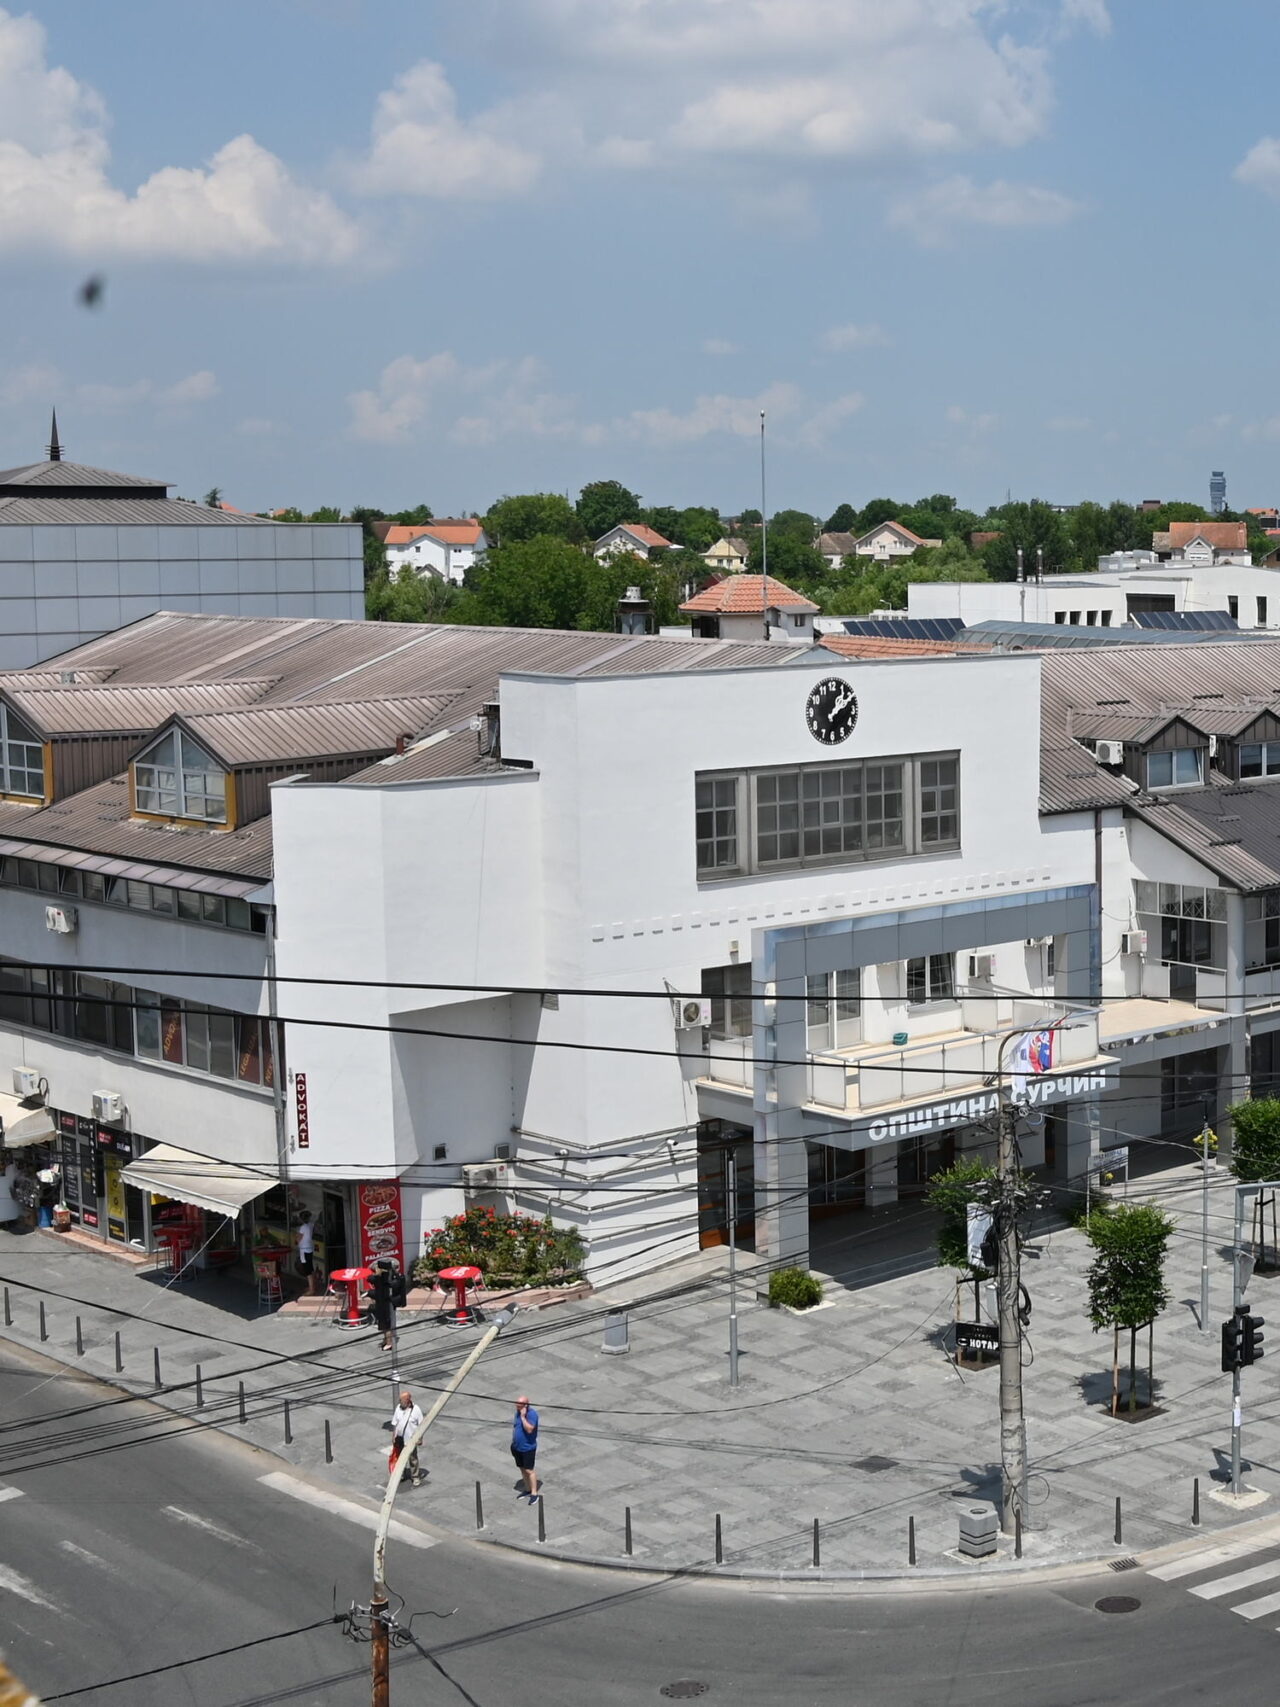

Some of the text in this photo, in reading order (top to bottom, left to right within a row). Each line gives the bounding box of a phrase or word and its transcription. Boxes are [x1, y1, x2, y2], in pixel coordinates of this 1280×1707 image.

[819, 685, 827, 695] 11
[828, 681, 836, 691] 12
[812, 695, 820, 704] 10
[809, 707, 814, 717] 9
[851, 705, 855, 715] 3
[813, 721, 817, 730] 8
[847, 717, 852, 726] 4
[821, 729, 826, 738] 7
[830, 731, 835, 741] 6
[840, 727, 844, 737] 5
[296, 1074, 308, 1140] ADVOKAT
[868, 1069, 1106, 1141] ОПШТИНА СУРЧИН
[369, 1205, 391, 1214] PIZZA
[365, 1250, 399, 1262] PALAČINKA
